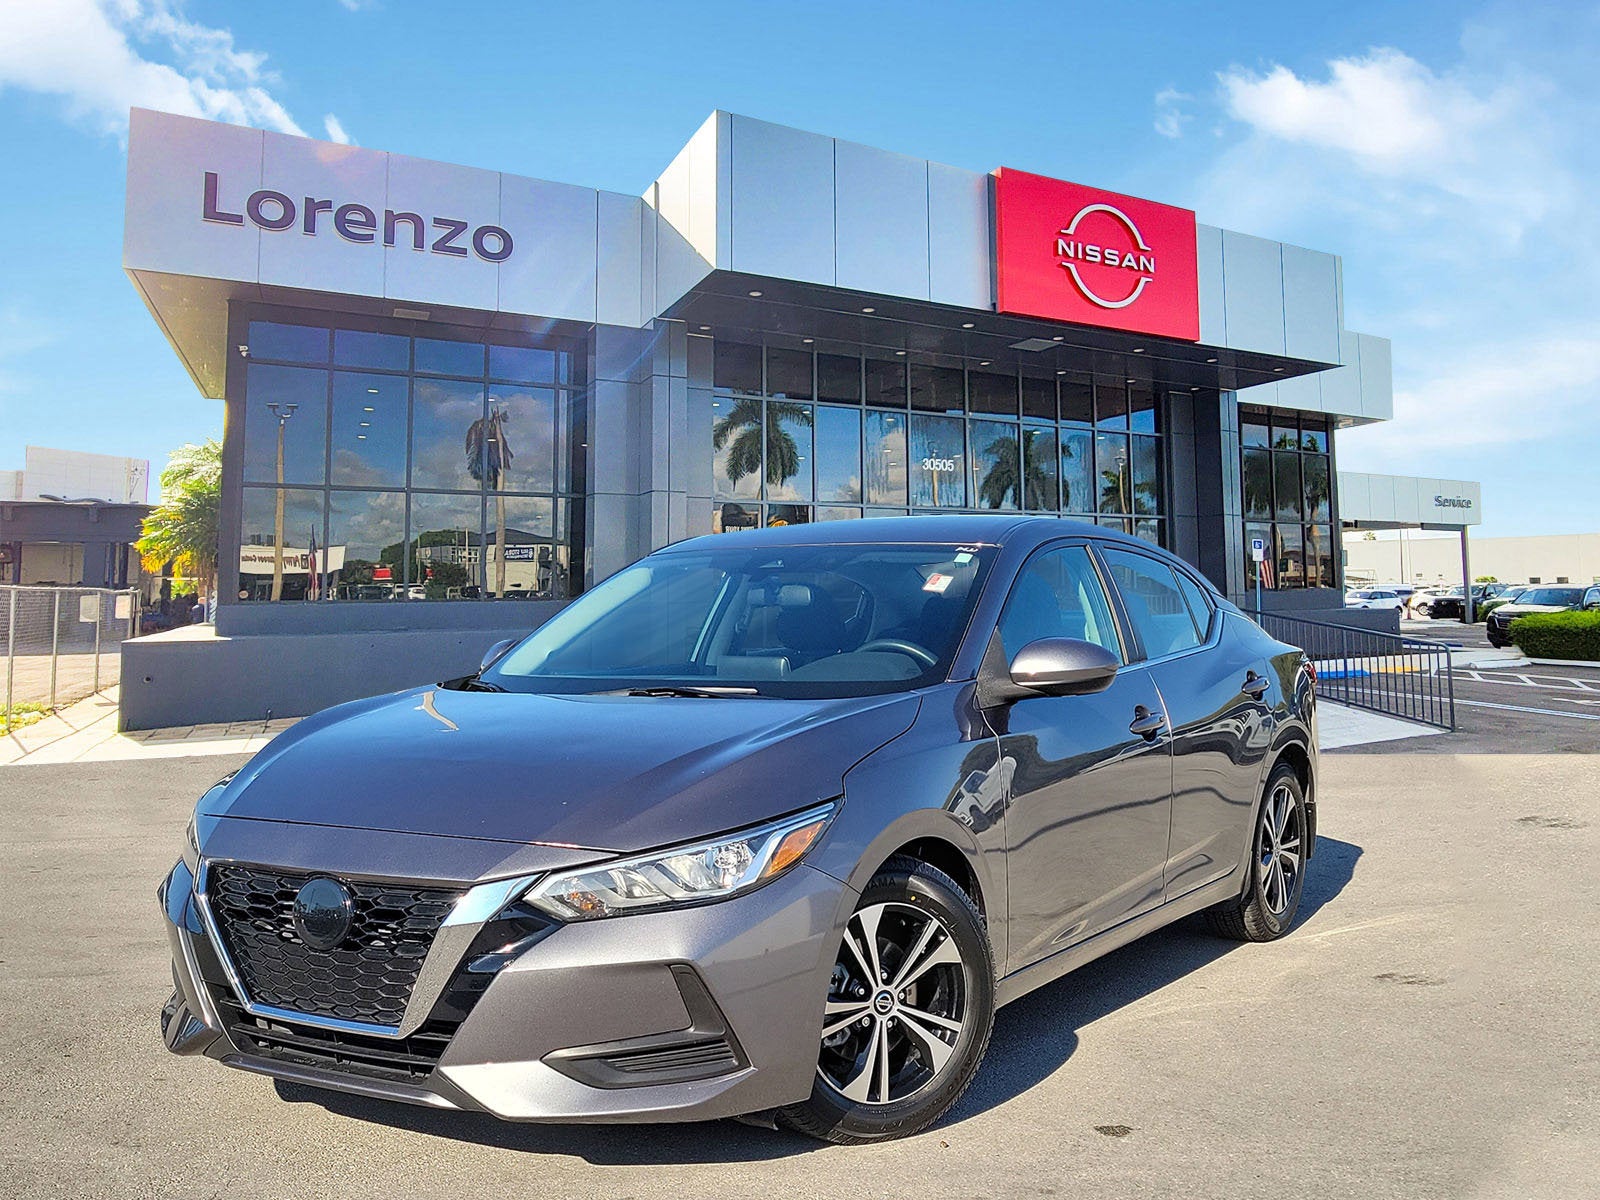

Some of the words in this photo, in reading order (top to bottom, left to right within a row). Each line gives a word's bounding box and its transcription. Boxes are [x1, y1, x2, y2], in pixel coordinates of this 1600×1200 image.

[202, 171, 515, 263] Lorenzo
[1057, 238, 1155, 273] NISSAN
[922, 457, 954, 472] 30505
[1434, 495, 1472, 508] Service
